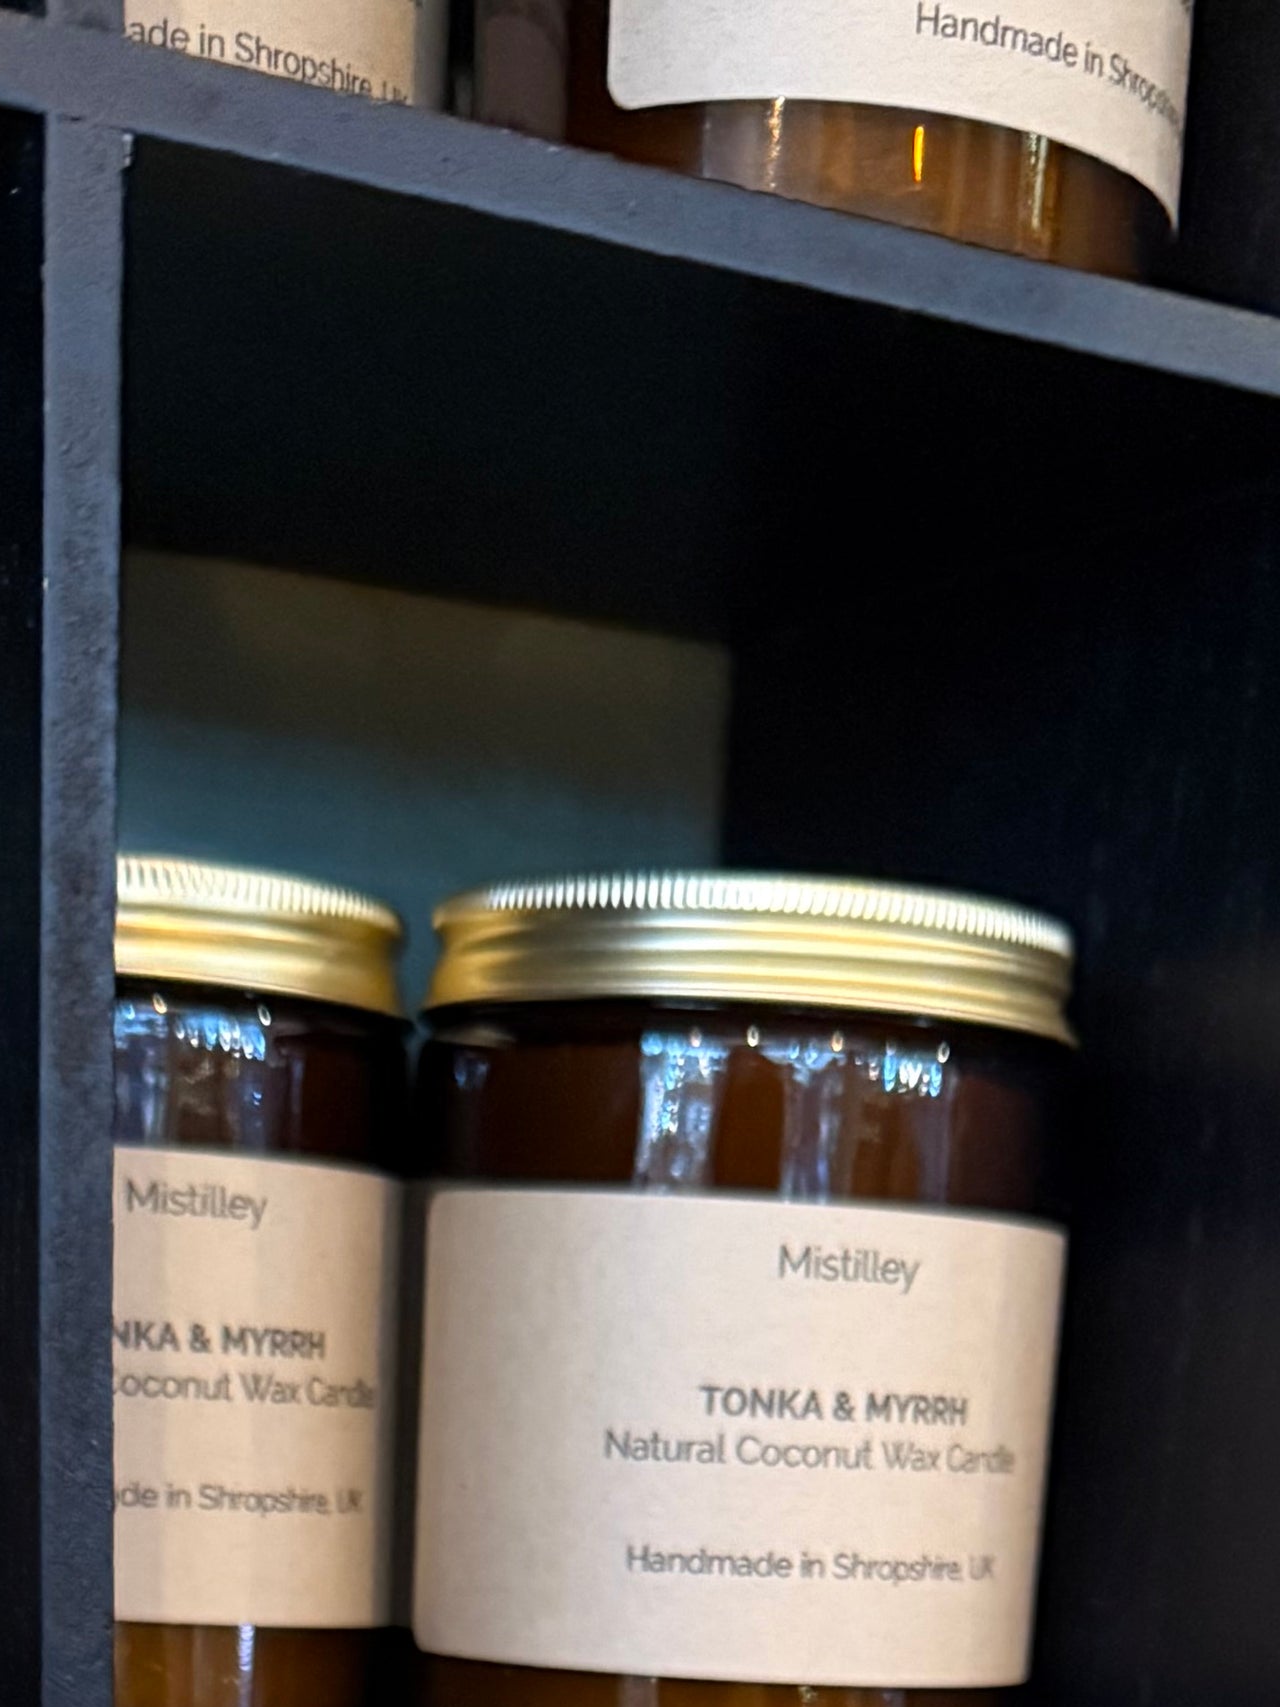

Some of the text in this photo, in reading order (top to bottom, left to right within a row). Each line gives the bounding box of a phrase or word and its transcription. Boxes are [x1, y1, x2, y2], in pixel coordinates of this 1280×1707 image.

[199, 23, 225, 57] in
[915, 2, 1078, 68] Handmade
[1083, 42, 1104, 78] in
[126, 1177, 268, 1231] Mistilley
[777, 1243, 920, 1296] Mistilley
[113, 1319, 326, 1360] NKA & MYRRH
[113, 1369, 231, 1403] oconut
[239, 1373, 300, 1405] Wax
[699, 1384, 969, 1427] TONKA & MYRRH
[603, 1429, 727, 1465] Natural
[735, 1434, 873, 1471] Coconut
[881, 1441, 939, 1473] Wax
[166, 1482, 192, 1510] in
[626, 1543, 794, 1579] Handmade
[800, 1551, 827, 1579] in
[969, 1554, 996, 1581] UK
